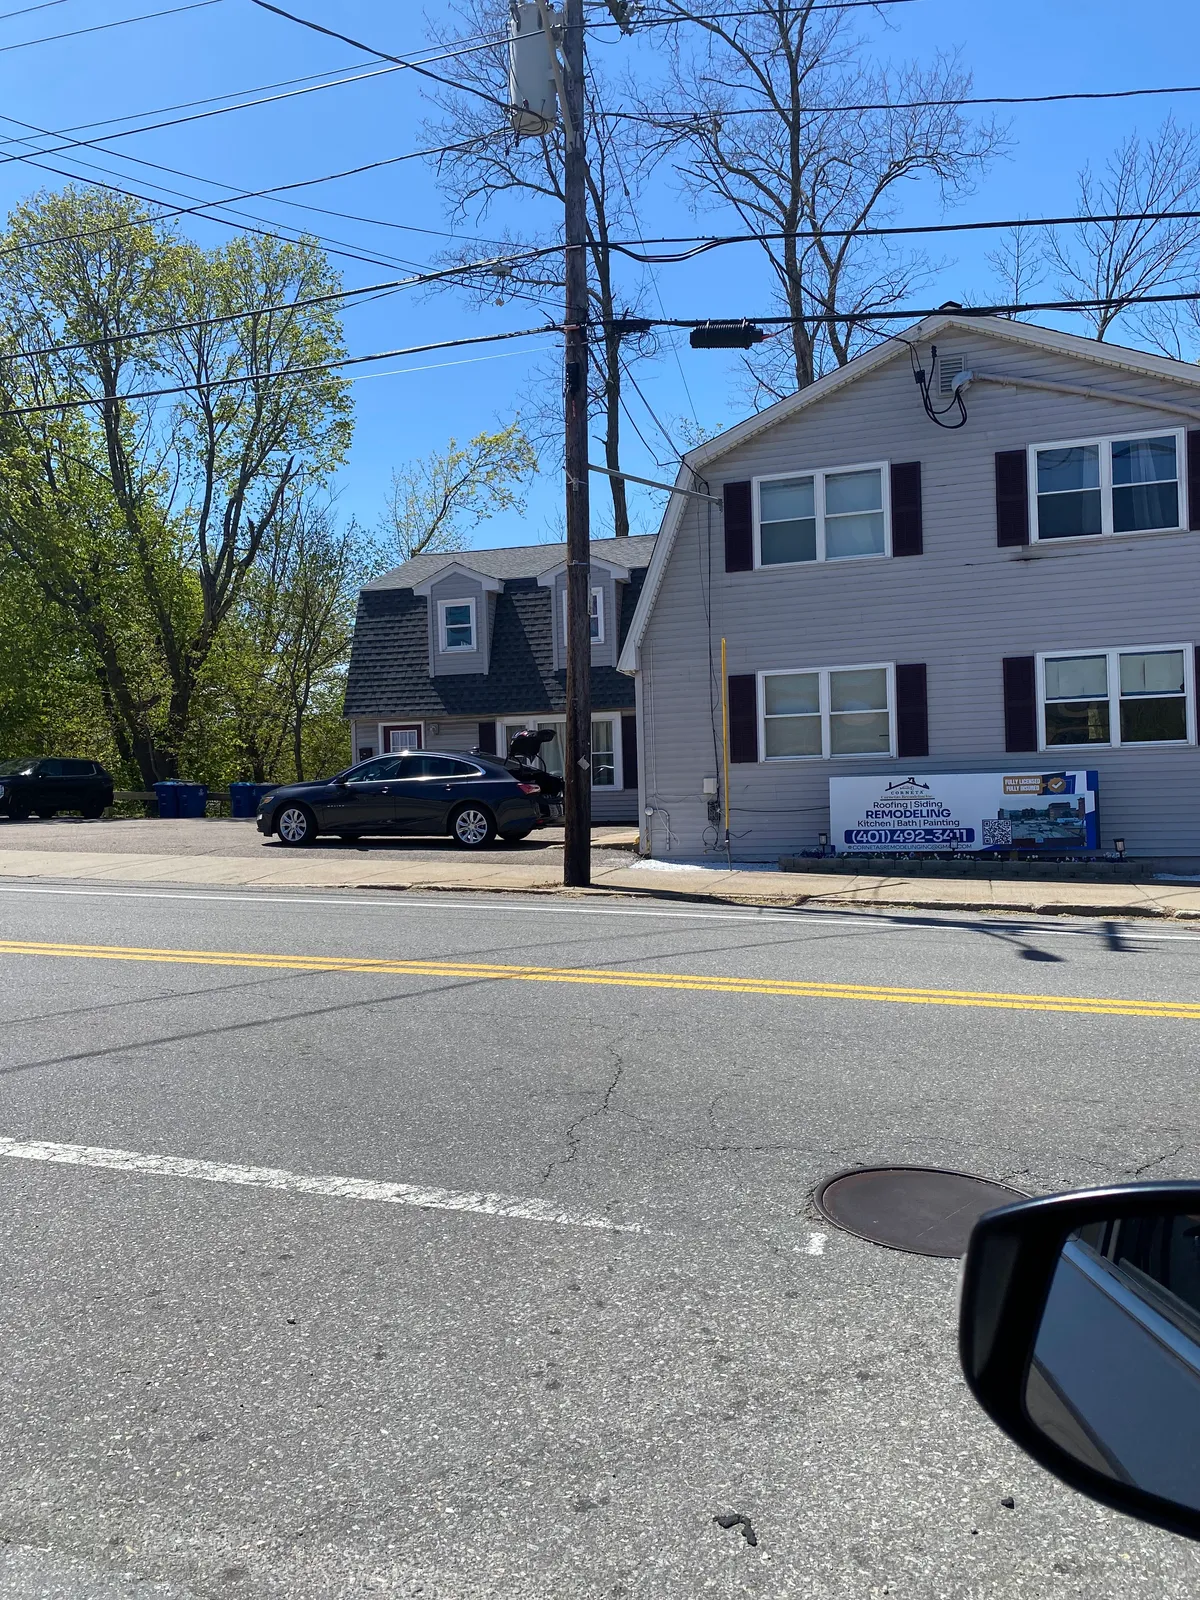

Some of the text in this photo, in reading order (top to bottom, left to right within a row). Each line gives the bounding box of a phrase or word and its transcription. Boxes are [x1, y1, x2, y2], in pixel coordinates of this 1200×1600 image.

[873, 801, 943, 809] Roofing Siding
[866, 808, 951, 819] REMODELING
[857, 818, 960, 828] Kitchen Bath Painting
[851, 829, 967, 844] (401) 492-3411
